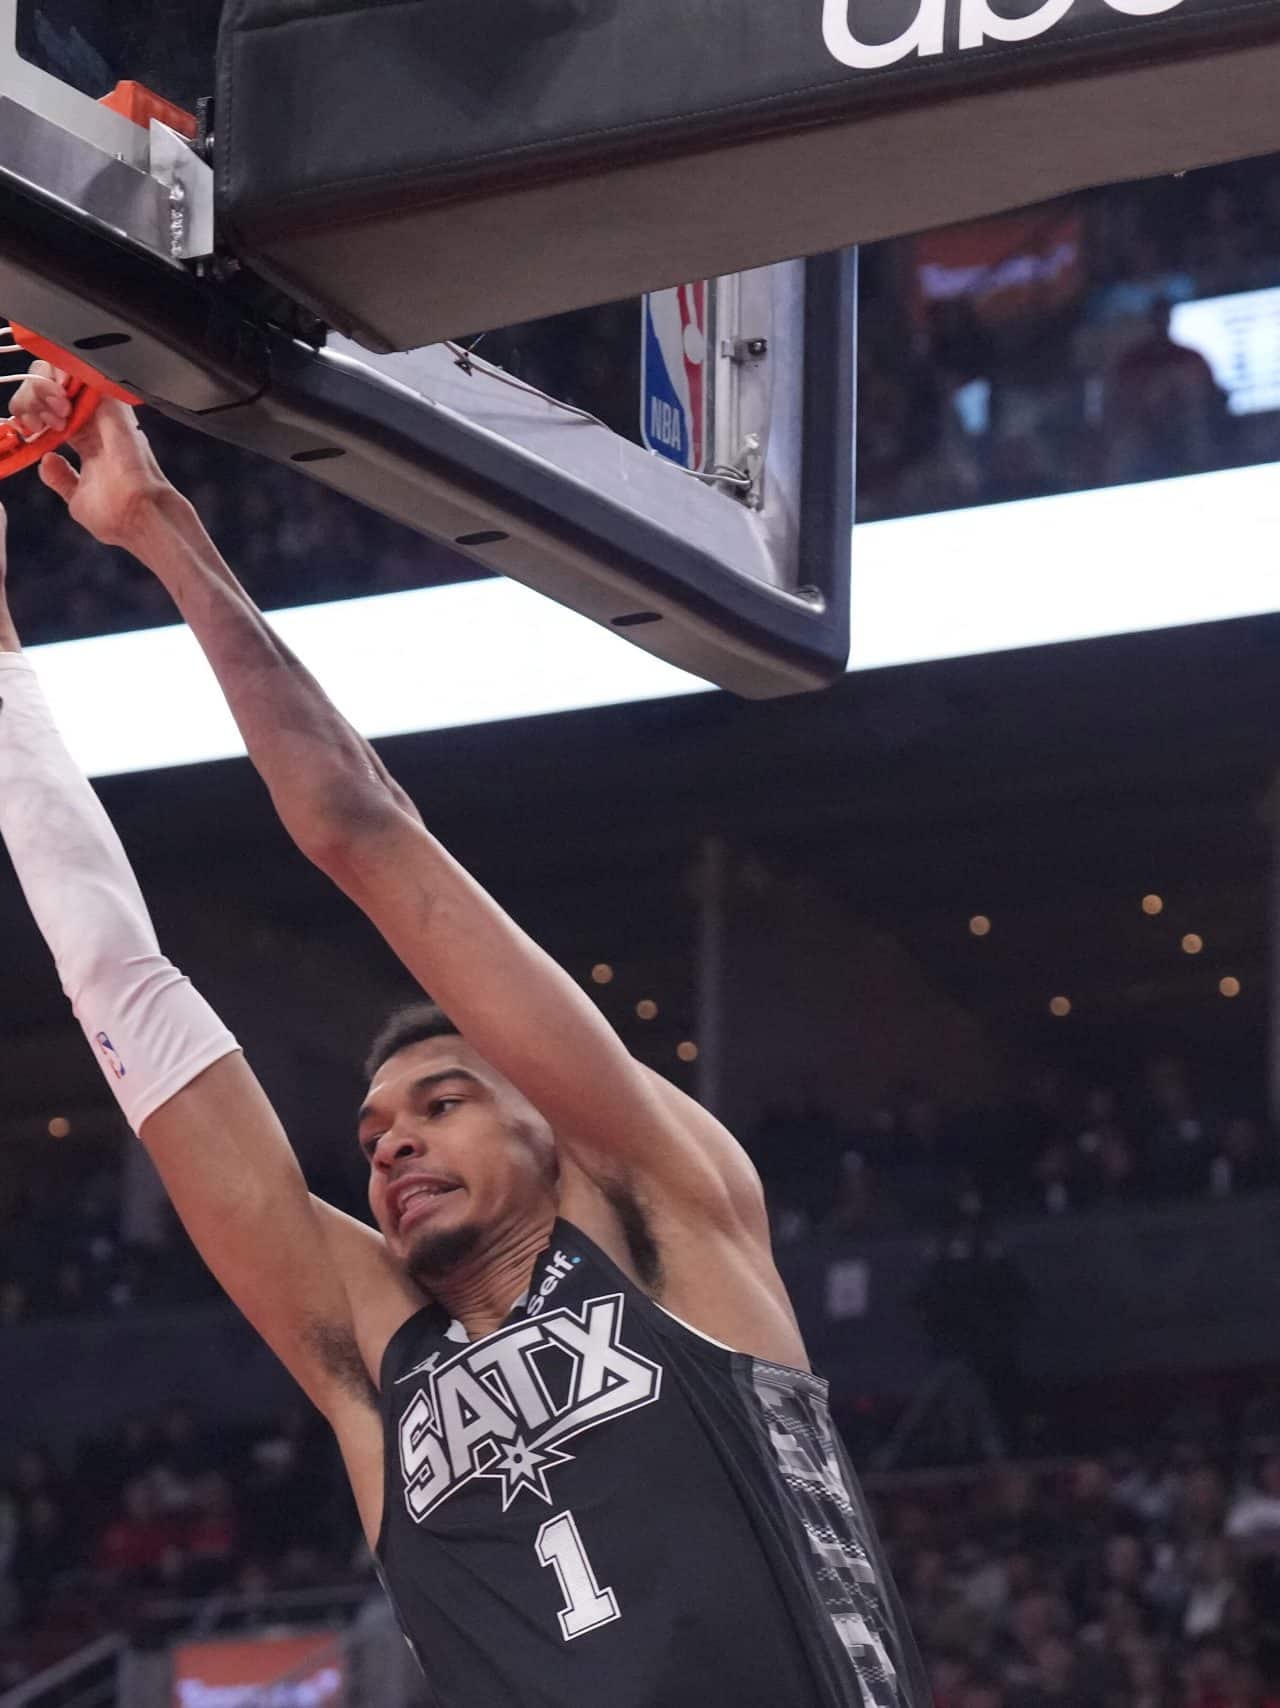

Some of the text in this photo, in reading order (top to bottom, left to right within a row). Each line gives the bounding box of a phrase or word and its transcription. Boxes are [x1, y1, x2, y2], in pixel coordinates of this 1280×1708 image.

[650, 396, 682, 451] NBA
[398, 1292, 663, 1524] SATX
[533, 1509, 622, 1642] 1
